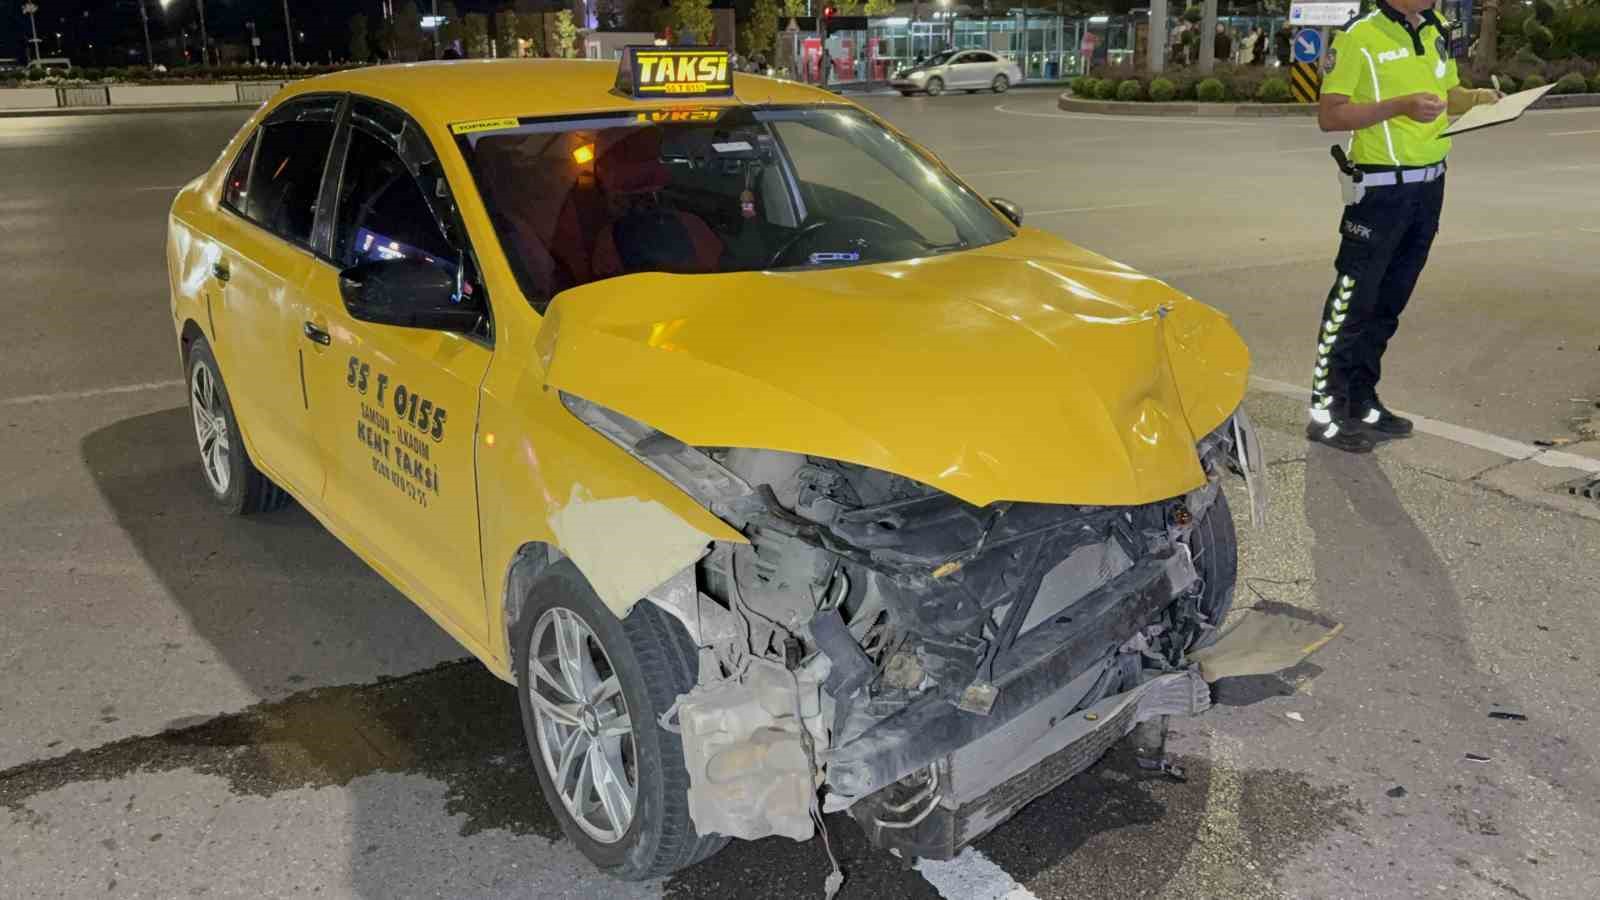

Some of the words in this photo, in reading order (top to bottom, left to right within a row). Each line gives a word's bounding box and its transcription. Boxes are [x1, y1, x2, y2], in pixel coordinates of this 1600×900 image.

[376, 373, 388, 408] T
[393, 384, 447, 442] 0155
[357, 420, 390, 459] KENT
